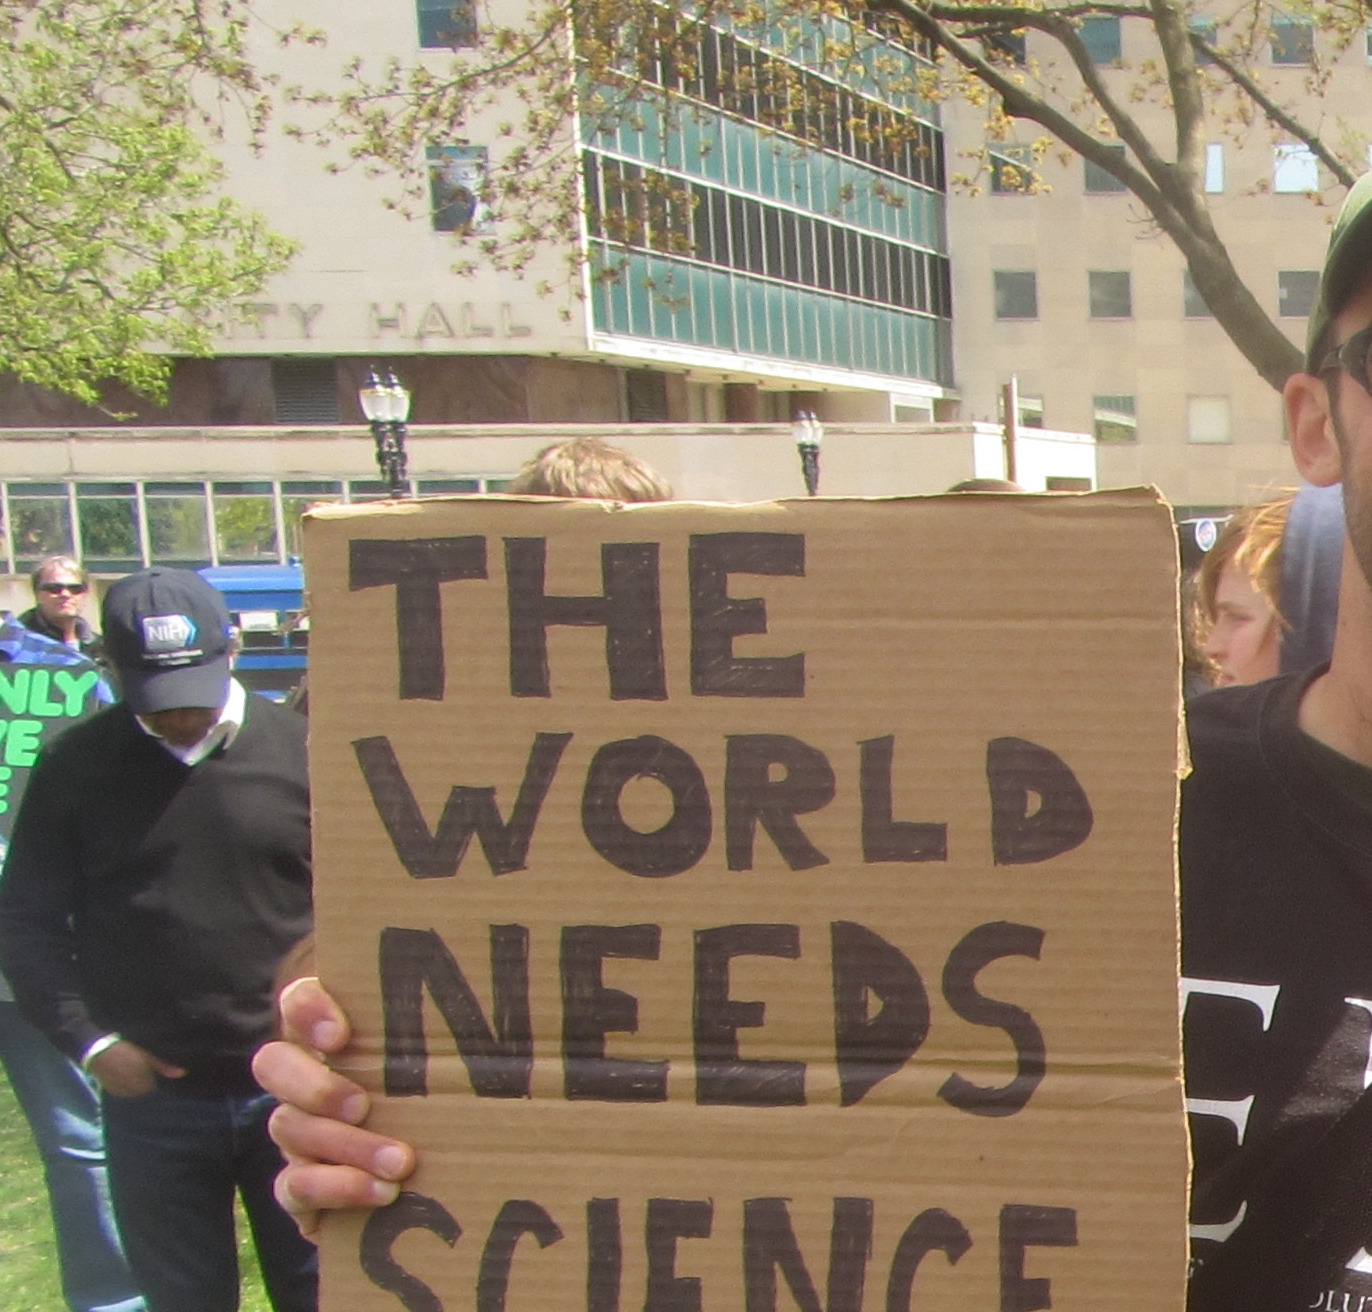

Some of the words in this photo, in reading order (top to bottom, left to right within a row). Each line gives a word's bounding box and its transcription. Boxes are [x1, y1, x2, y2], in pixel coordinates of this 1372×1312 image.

[368, 301, 533, 340] HALL
[149, 622, 185, 642] NIH
[348, 532, 807, 702] THE
[350, 731, 1095, 879] WORLD
[379, 920, 1047, 1118] NEEDS
